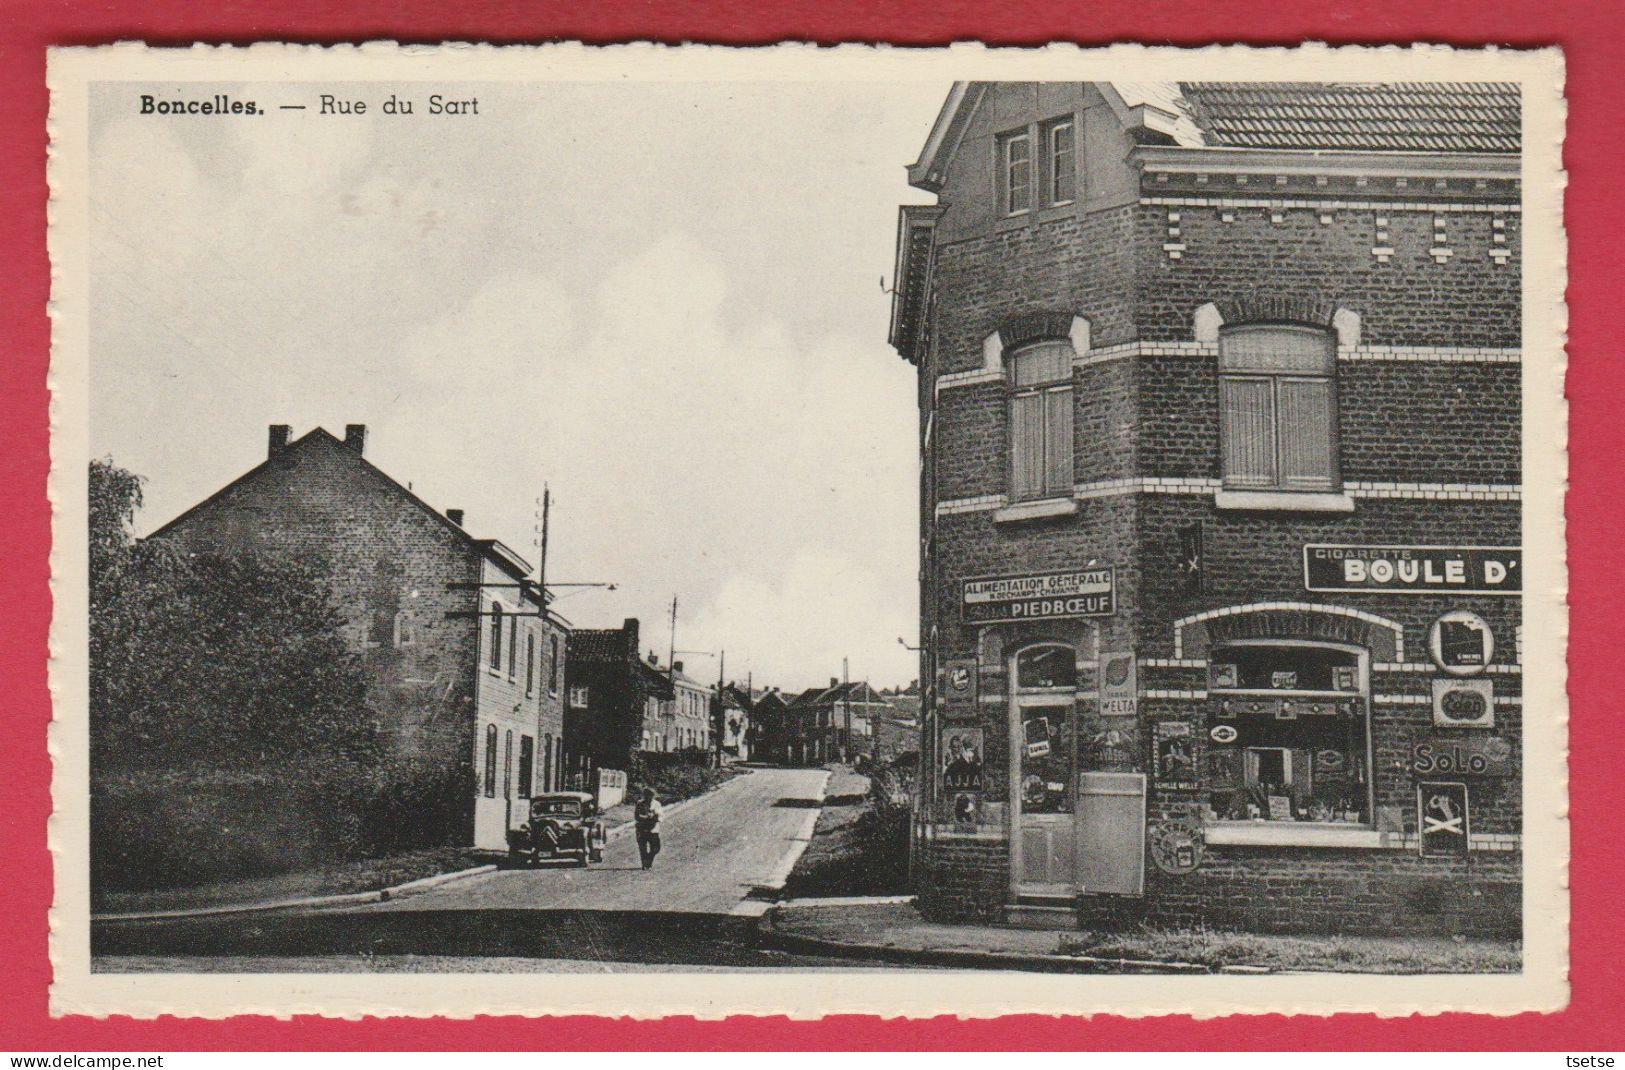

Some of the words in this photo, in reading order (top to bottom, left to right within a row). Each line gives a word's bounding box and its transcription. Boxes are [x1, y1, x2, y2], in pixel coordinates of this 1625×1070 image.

[1315, 549, 1412, 560] CIGARETTE
[1344, 559, 1466, 583] BOULE
[966, 578, 1044, 594] ALIMENTATION
[946, 774, 981, 787] AJJA
